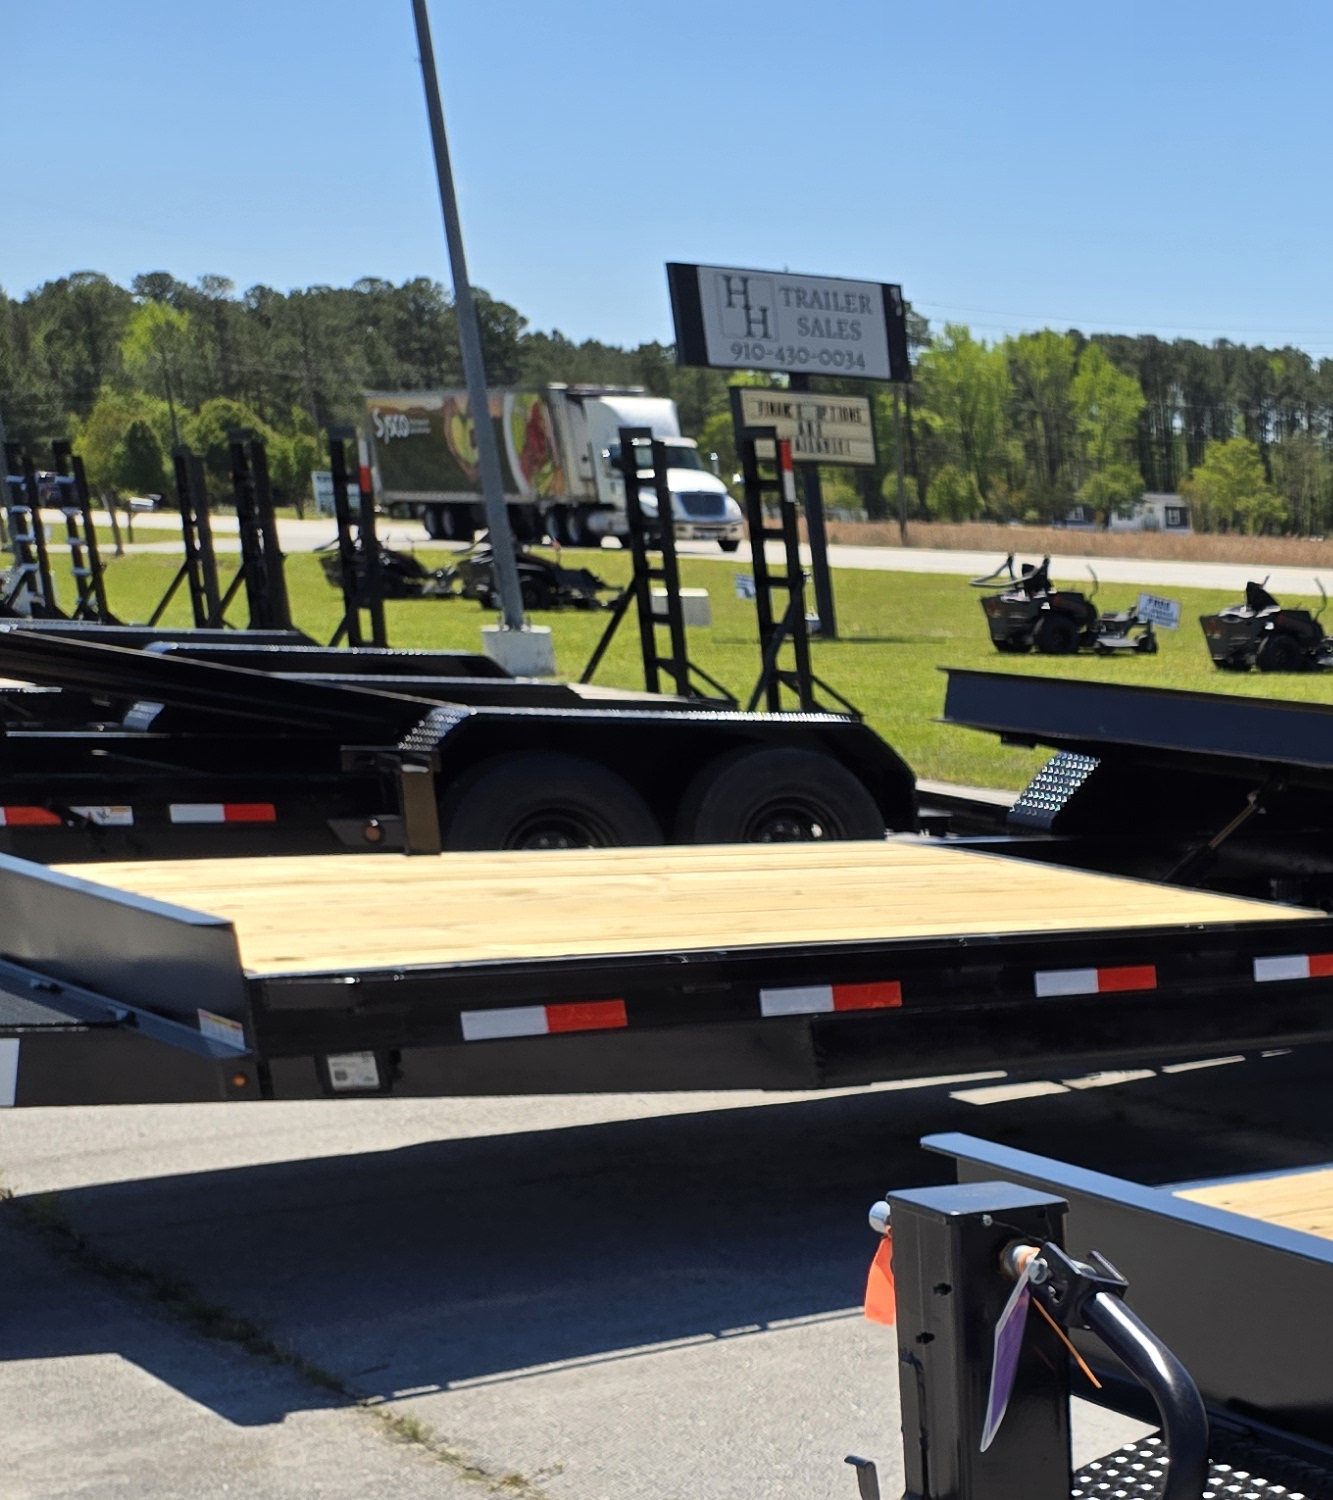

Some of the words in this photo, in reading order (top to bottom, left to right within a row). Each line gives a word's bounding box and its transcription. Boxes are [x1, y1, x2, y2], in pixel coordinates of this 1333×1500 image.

[779, 285, 873, 316] TRAILER
[797, 315, 863, 342] SALES
[730, 342, 866, 372] 910-430-0034
